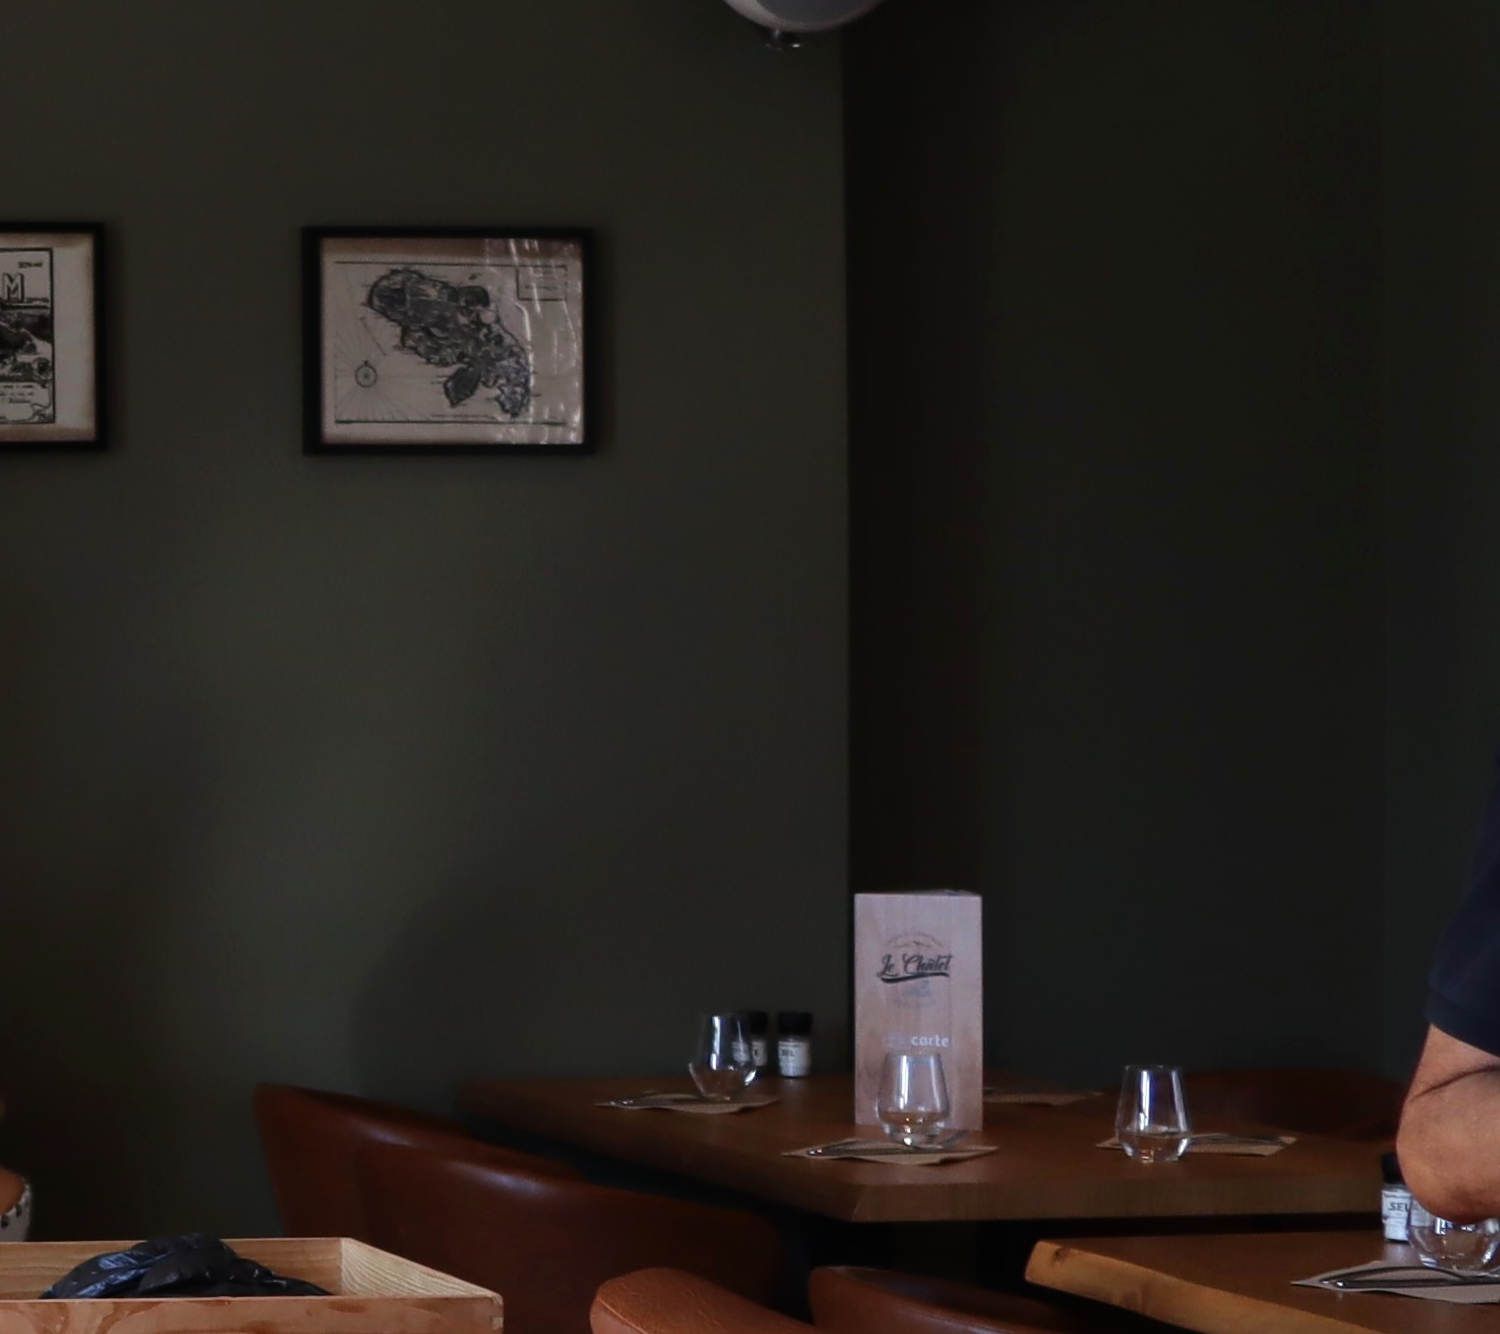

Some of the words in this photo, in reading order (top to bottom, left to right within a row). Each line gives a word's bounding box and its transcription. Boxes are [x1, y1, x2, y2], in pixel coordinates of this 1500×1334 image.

[876, 954, 900, 978] Le
[902, 953, 954, 976] Châlet
[911, 1034, 949, 1048] carte
